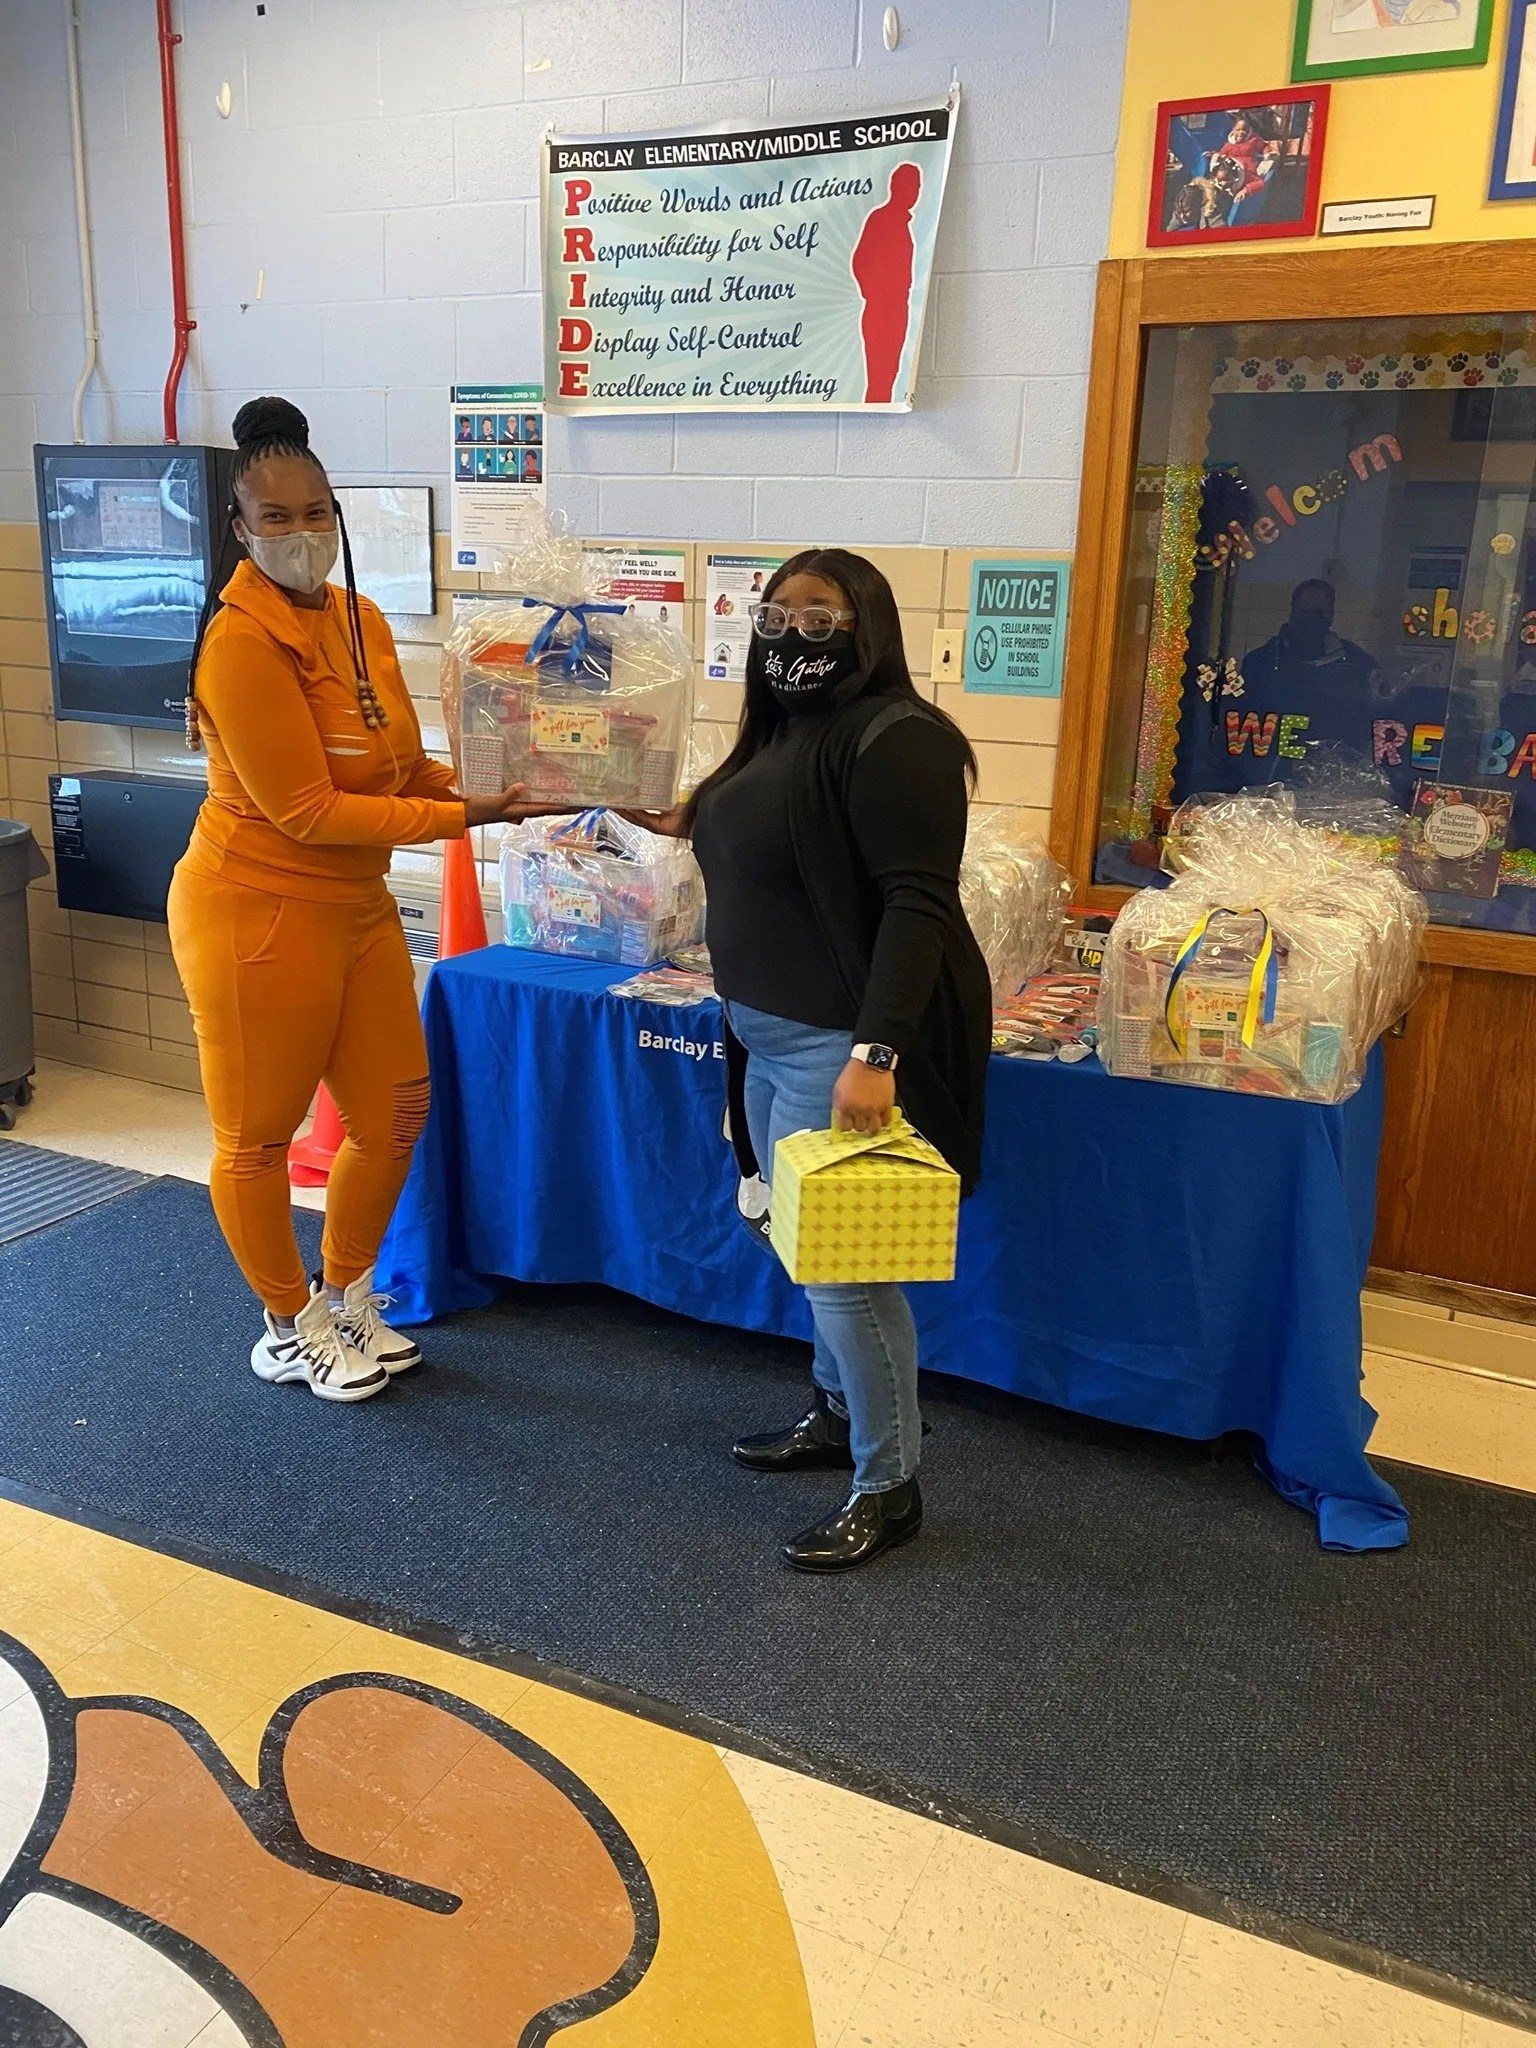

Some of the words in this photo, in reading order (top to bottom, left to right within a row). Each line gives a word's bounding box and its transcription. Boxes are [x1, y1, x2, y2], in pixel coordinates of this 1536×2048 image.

[558, 149, 634, 169] BARCLAY
[645, 130, 842, 166] ELEMENTARY/MIDDLE
[854, 119, 938, 146] SCHOOL
[564, 179, 652, 217] Positive
[660, 185, 731, 215] Words
[739, 180, 784, 210] and
[789, 175, 873, 202] Actions
[562, 227, 721, 268] Responsibility
[727, 228, 762, 261] for
[769, 222, 820, 259] Self
[568, 273, 666, 316] Integrity
[671, 278, 712, 305] and
[720, 274, 797, 303] Honor
[558, 318, 660, 360] Display
[666, 322, 803, 358] Self-Control
[457, 392, 480, 401] Symptoms
[559, 362, 686, 399] Excellence
[692, 368, 712, 397] in
[719, 371, 839, 403] Everything
[624, 559, 638, 567] FEEL
[980, 578, 1054, 610] NOTICE
[1001, 623, 1030, 634] CELLULAR
[1031, 624, 1052, 635] PHONE
[1001, 638, 1013, 648] USE
[1014, 638, 1049, 649] PROHIBITED
[787, 655, 837, 685] Gather
[1007, 666, 1039, 677] BUILDINGS
[1008, 652, 1015, 662] IN
[1016, 652, 1040, 663] SCHOOL
[1225, 710, 1310, 760] WE
[638, 1029, 708, 1061] Barclay
